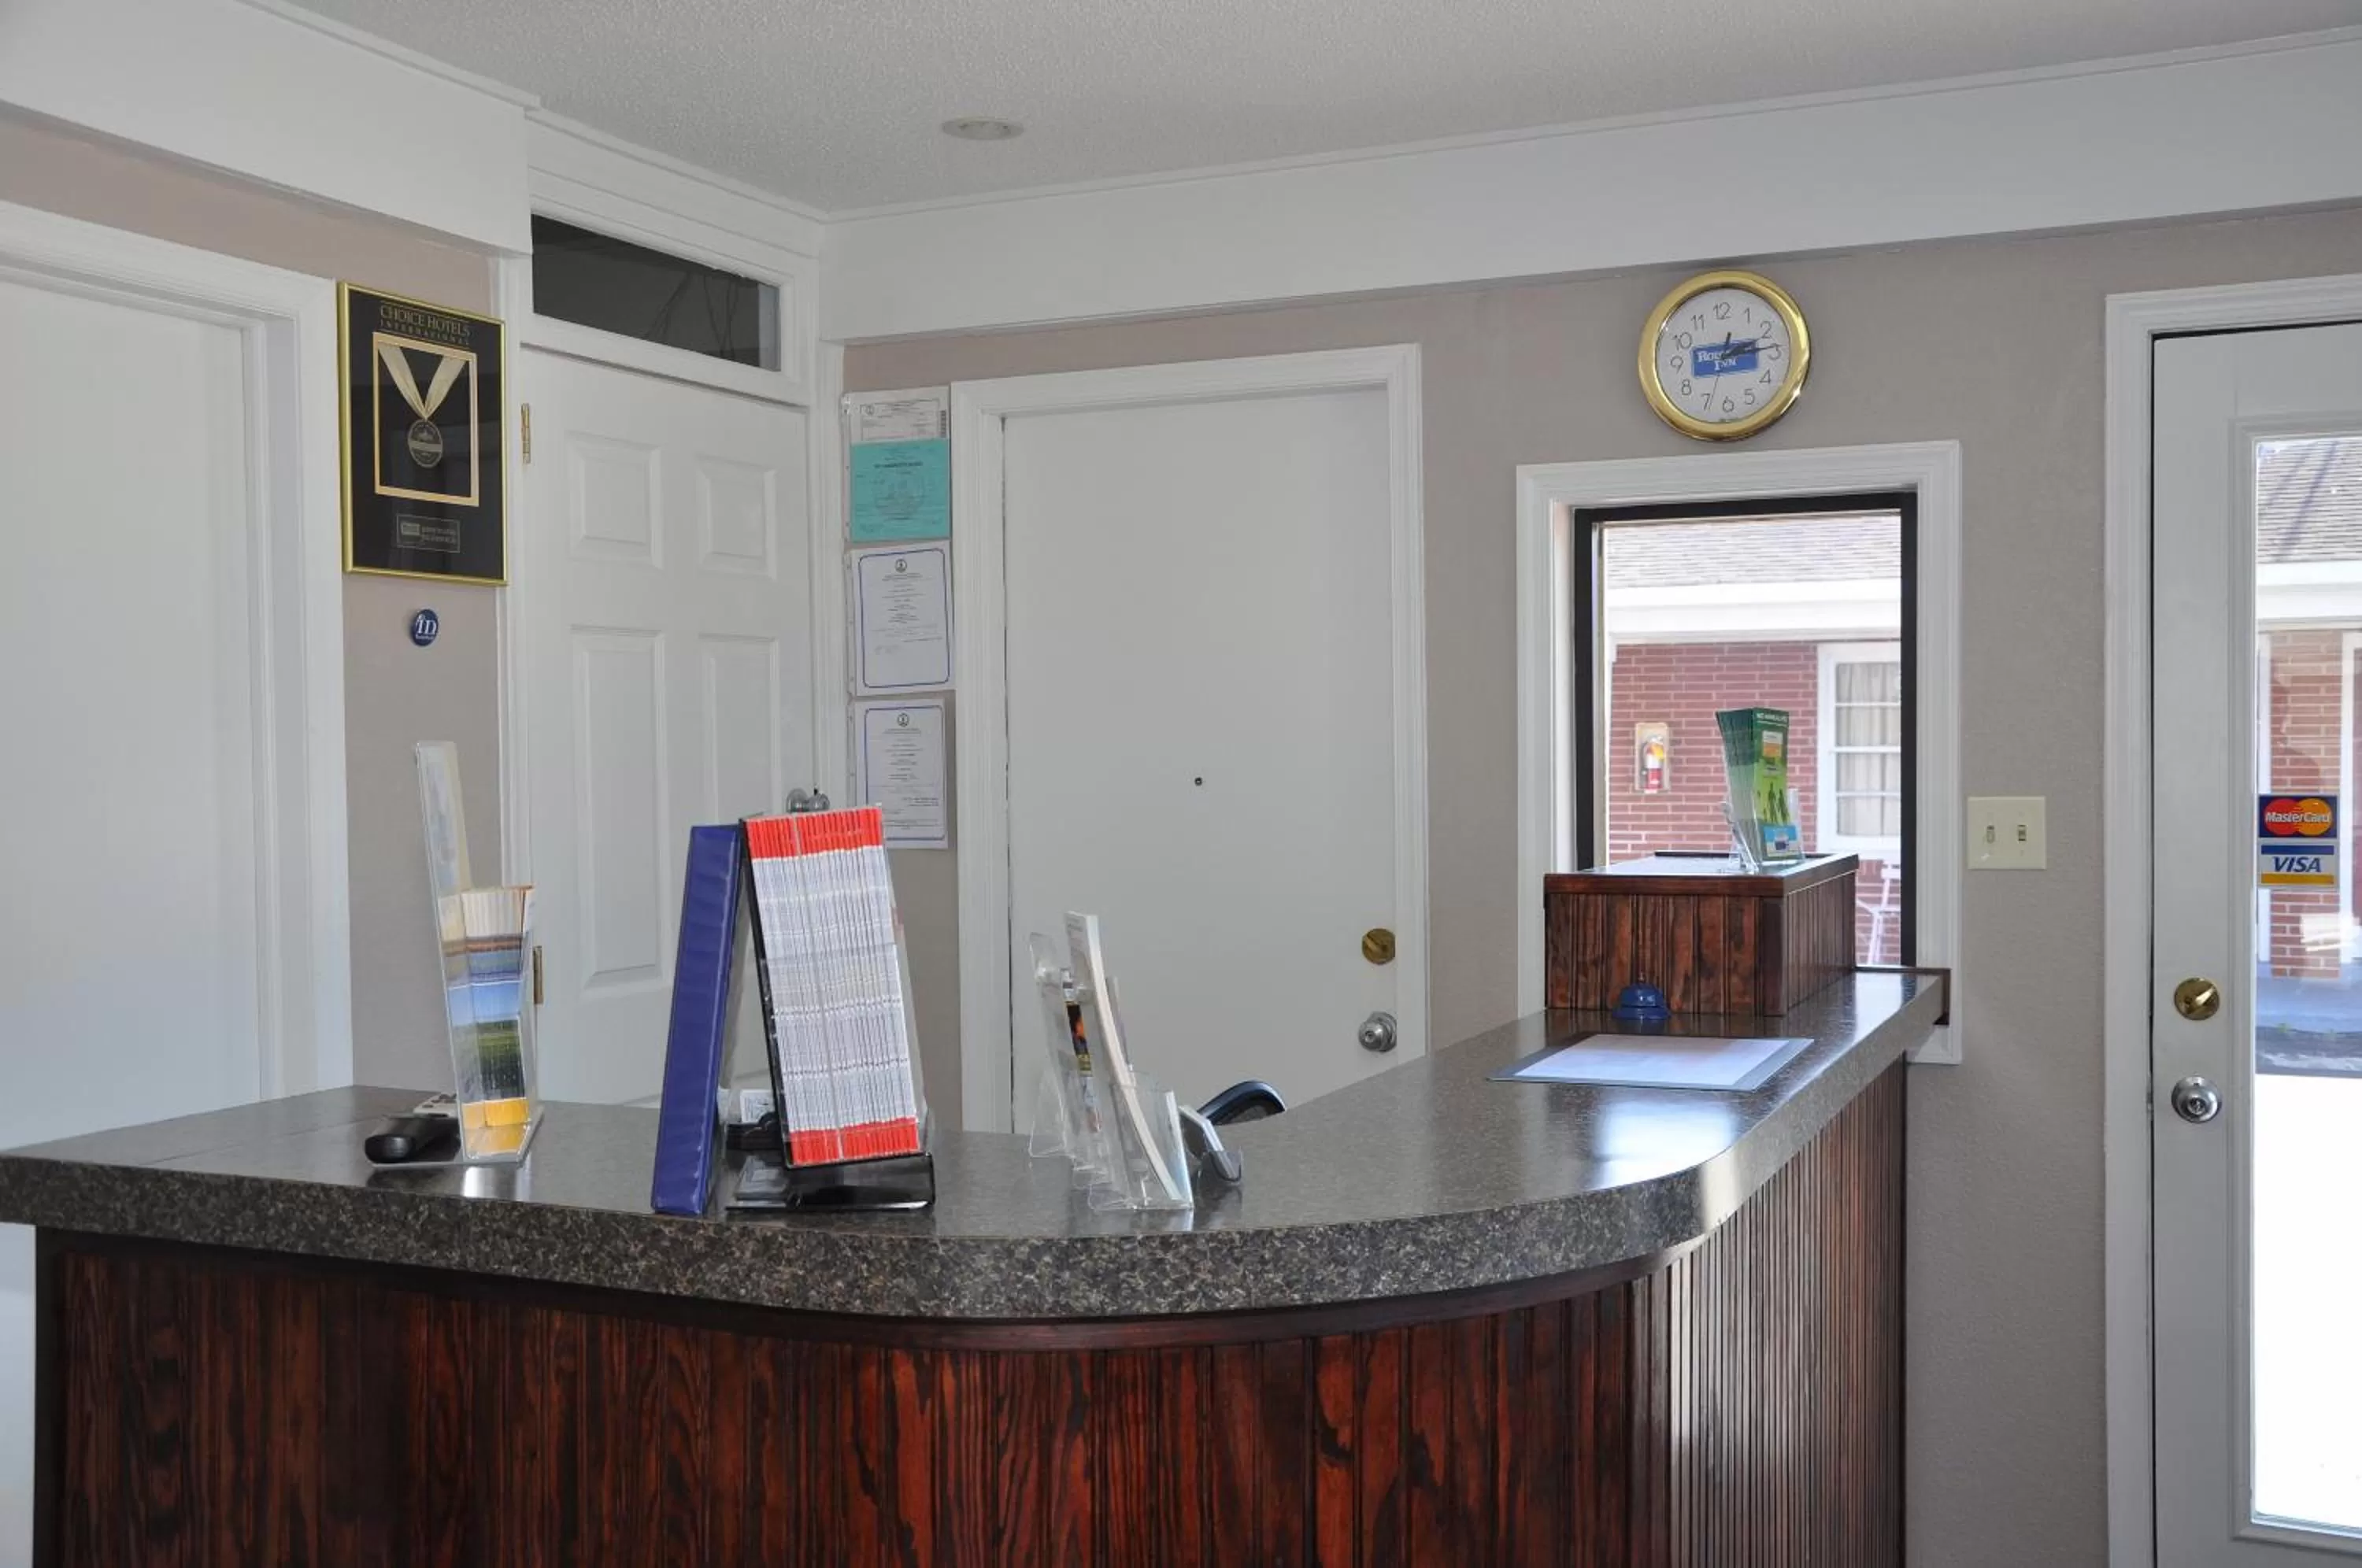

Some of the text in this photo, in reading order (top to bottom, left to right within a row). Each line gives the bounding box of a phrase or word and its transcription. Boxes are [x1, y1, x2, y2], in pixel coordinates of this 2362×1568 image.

[1713, 301, 1731, 320] 12
[1744, 308, 1750, 324] 1
[380, 305, 471, 337] CHOICE HOTELS
[1691, 314, 1705, 331] 11
[1760, 321, 1772, 338] 2
[1672, 331, 1692, 351] 10
[1768, 343, 1782, 361] 3
[1670, 356, 1683, 374] 9
[1759, 369, 1771, 384] 4
[1681, 379, 1692, 395] 8
[1701, 394, 1712, 411] 7
[1722, 396, 1734, 412] 6
[1744, 388, 1755, 405] 5
[2265, 812, 2331, 823] MasterCard
[2273, 856, 2322, 872] VISA
